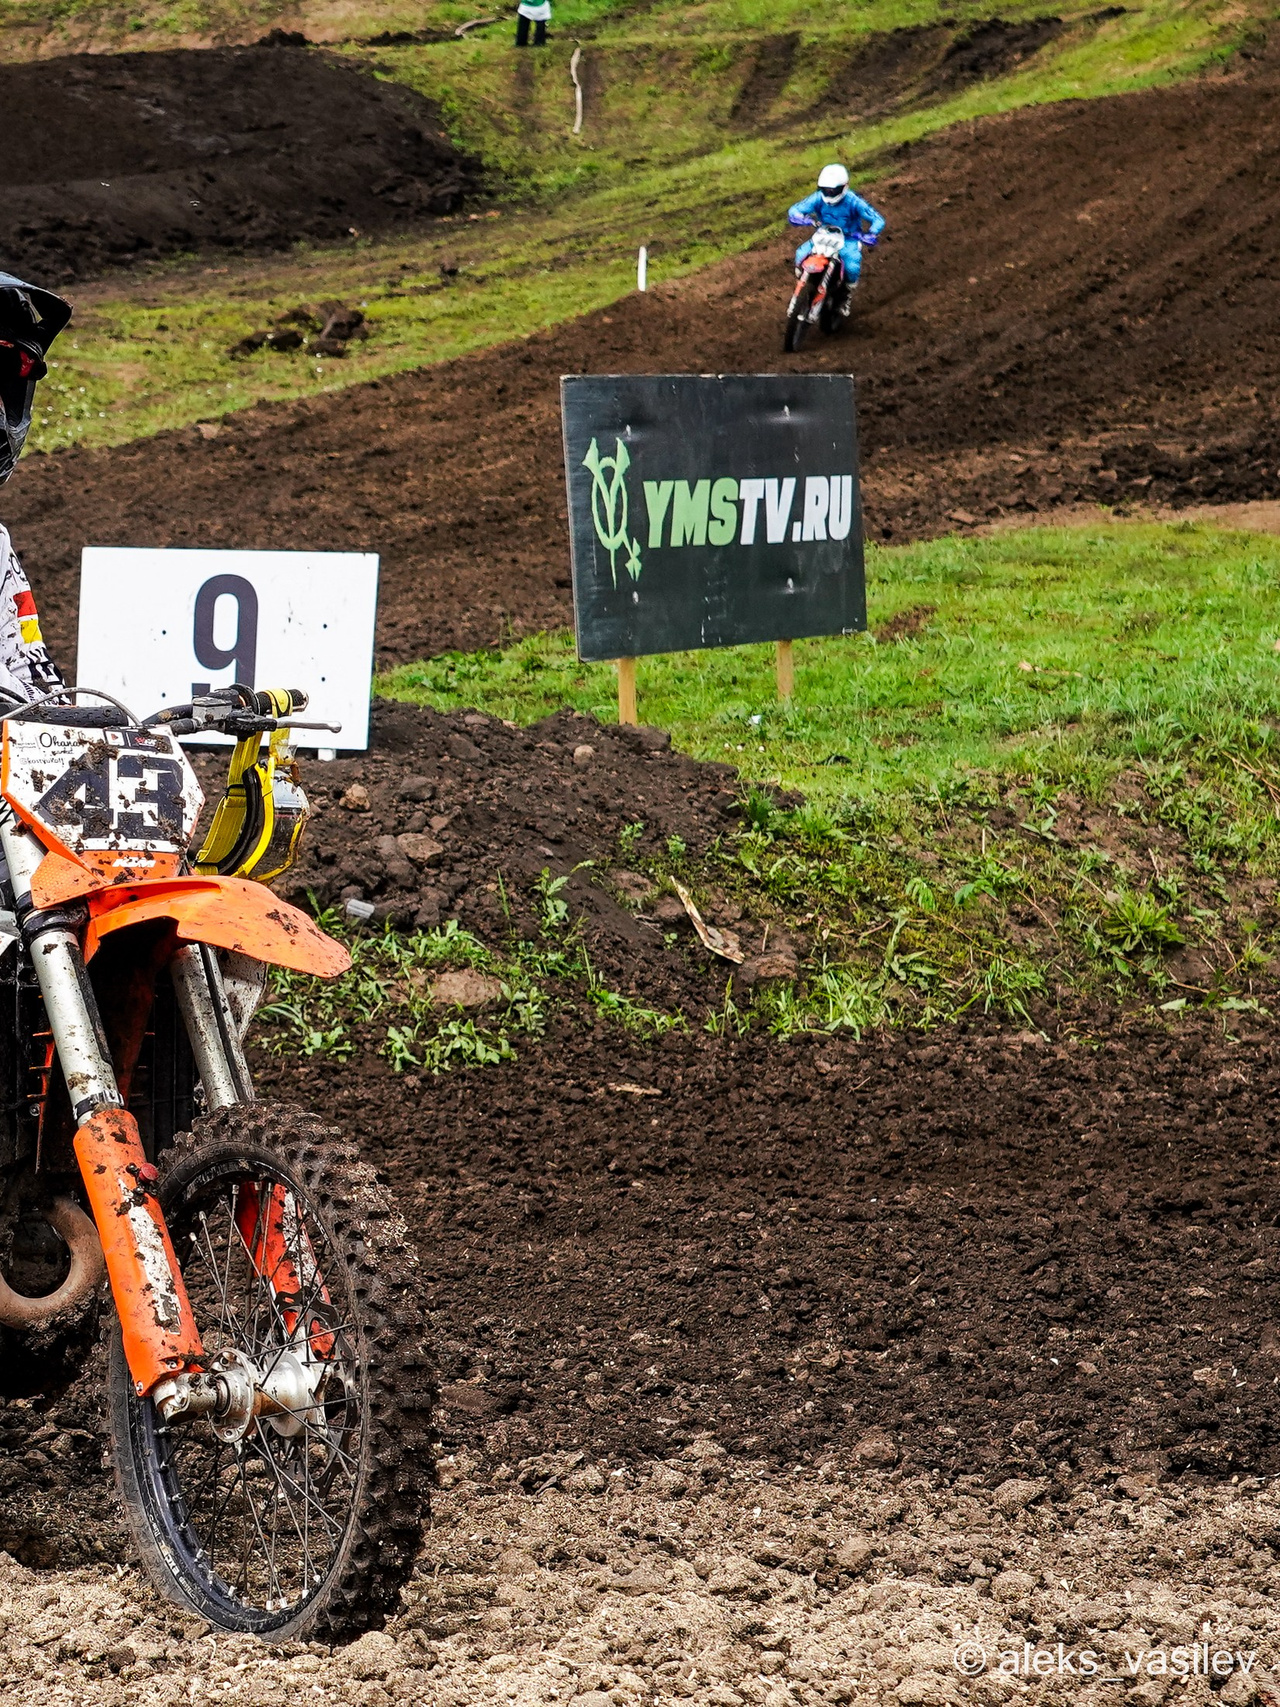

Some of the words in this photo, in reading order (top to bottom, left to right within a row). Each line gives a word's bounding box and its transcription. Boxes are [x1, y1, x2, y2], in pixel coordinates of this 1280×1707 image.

[642, 475, 853, 549] YMSTV.RU
[191, 573, 259, 700] 9
[38, 752, 184, 842] 43
